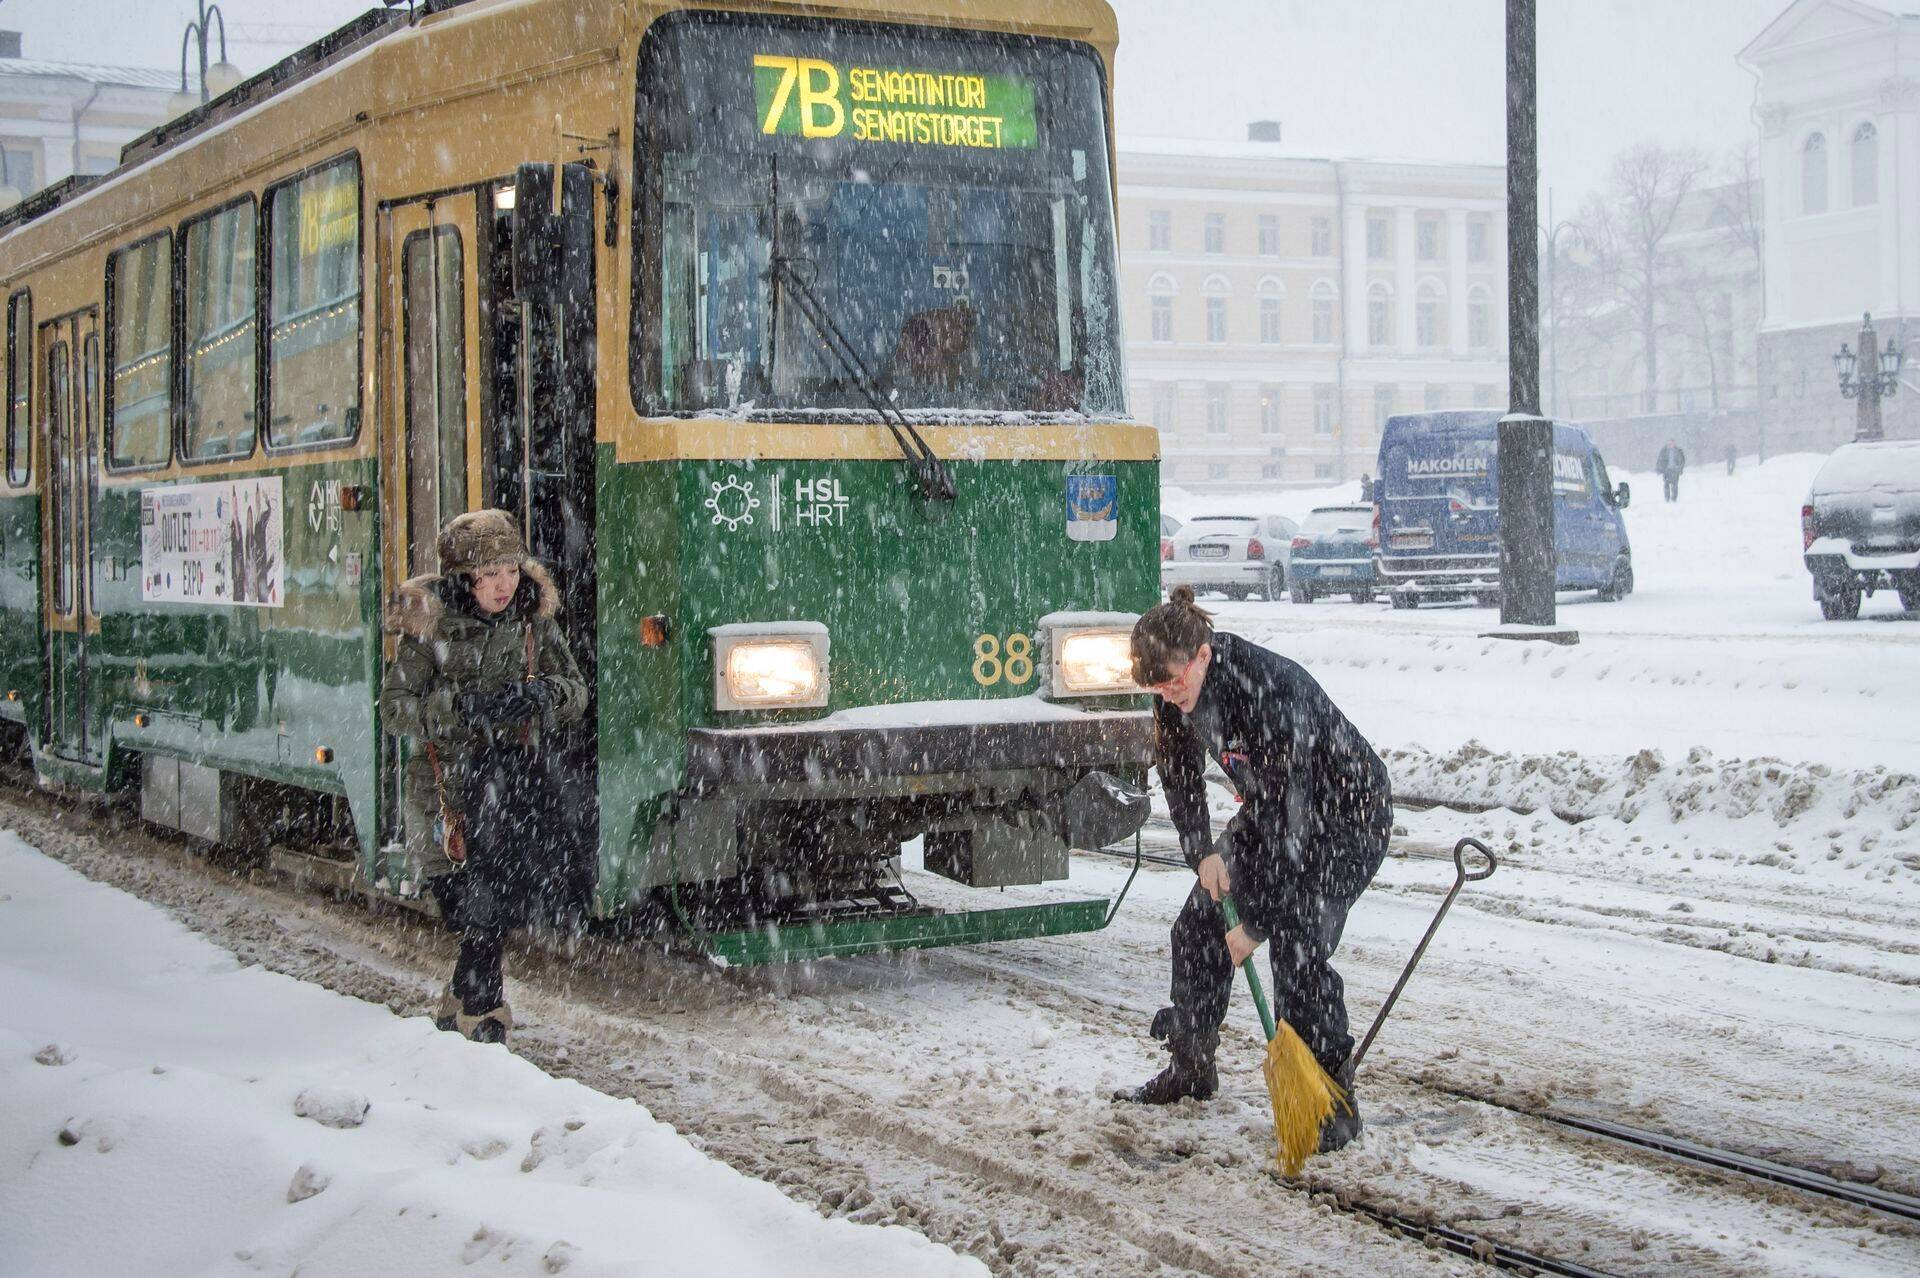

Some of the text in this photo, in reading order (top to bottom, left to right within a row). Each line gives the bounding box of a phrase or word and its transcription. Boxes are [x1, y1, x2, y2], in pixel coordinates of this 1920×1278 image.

[753, 54, 845, 138] 7B
[850, 68, 986, 109] SENAATINTORI
[852, 109, 1003, 148] SENATSTORGET
[1408, 457, 1487, 473] HAKONEN
[796, 479, 850, 502] HSL
[162, 512, 192, 552] OUTLET
[796, 503, 850, 527] HRT
[183, 560, 202, 596] EXPO
[972, 633, 1034, 685] 88
